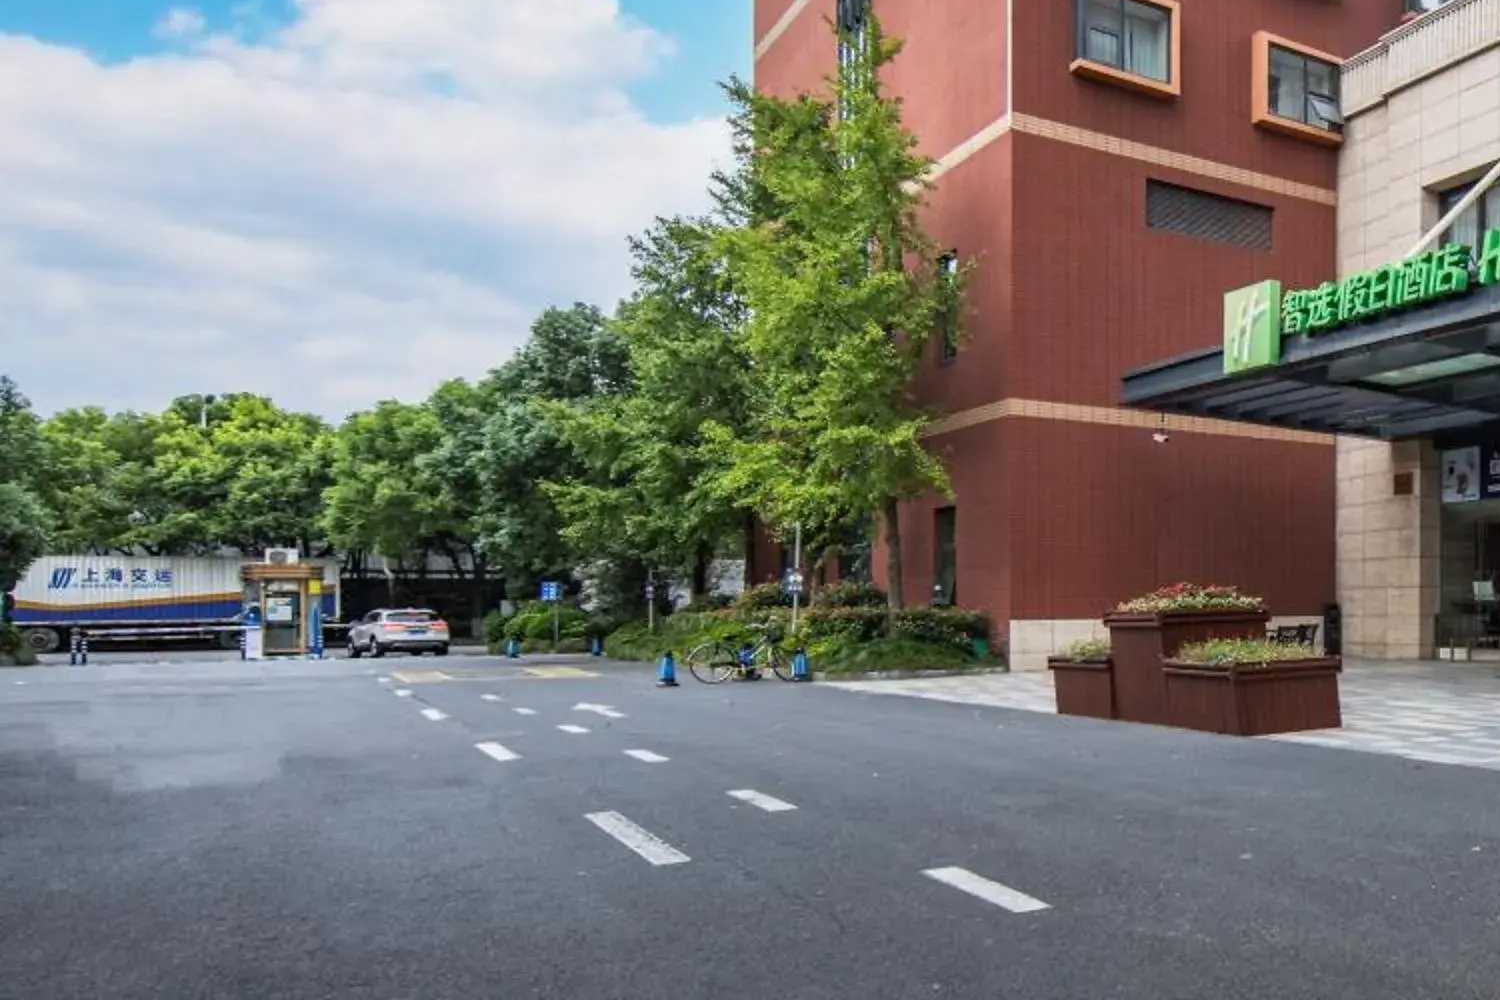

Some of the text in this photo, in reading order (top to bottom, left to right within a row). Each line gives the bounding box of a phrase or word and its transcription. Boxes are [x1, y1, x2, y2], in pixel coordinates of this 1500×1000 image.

[1282, 243, 1472, 333] 智选假日酒店
